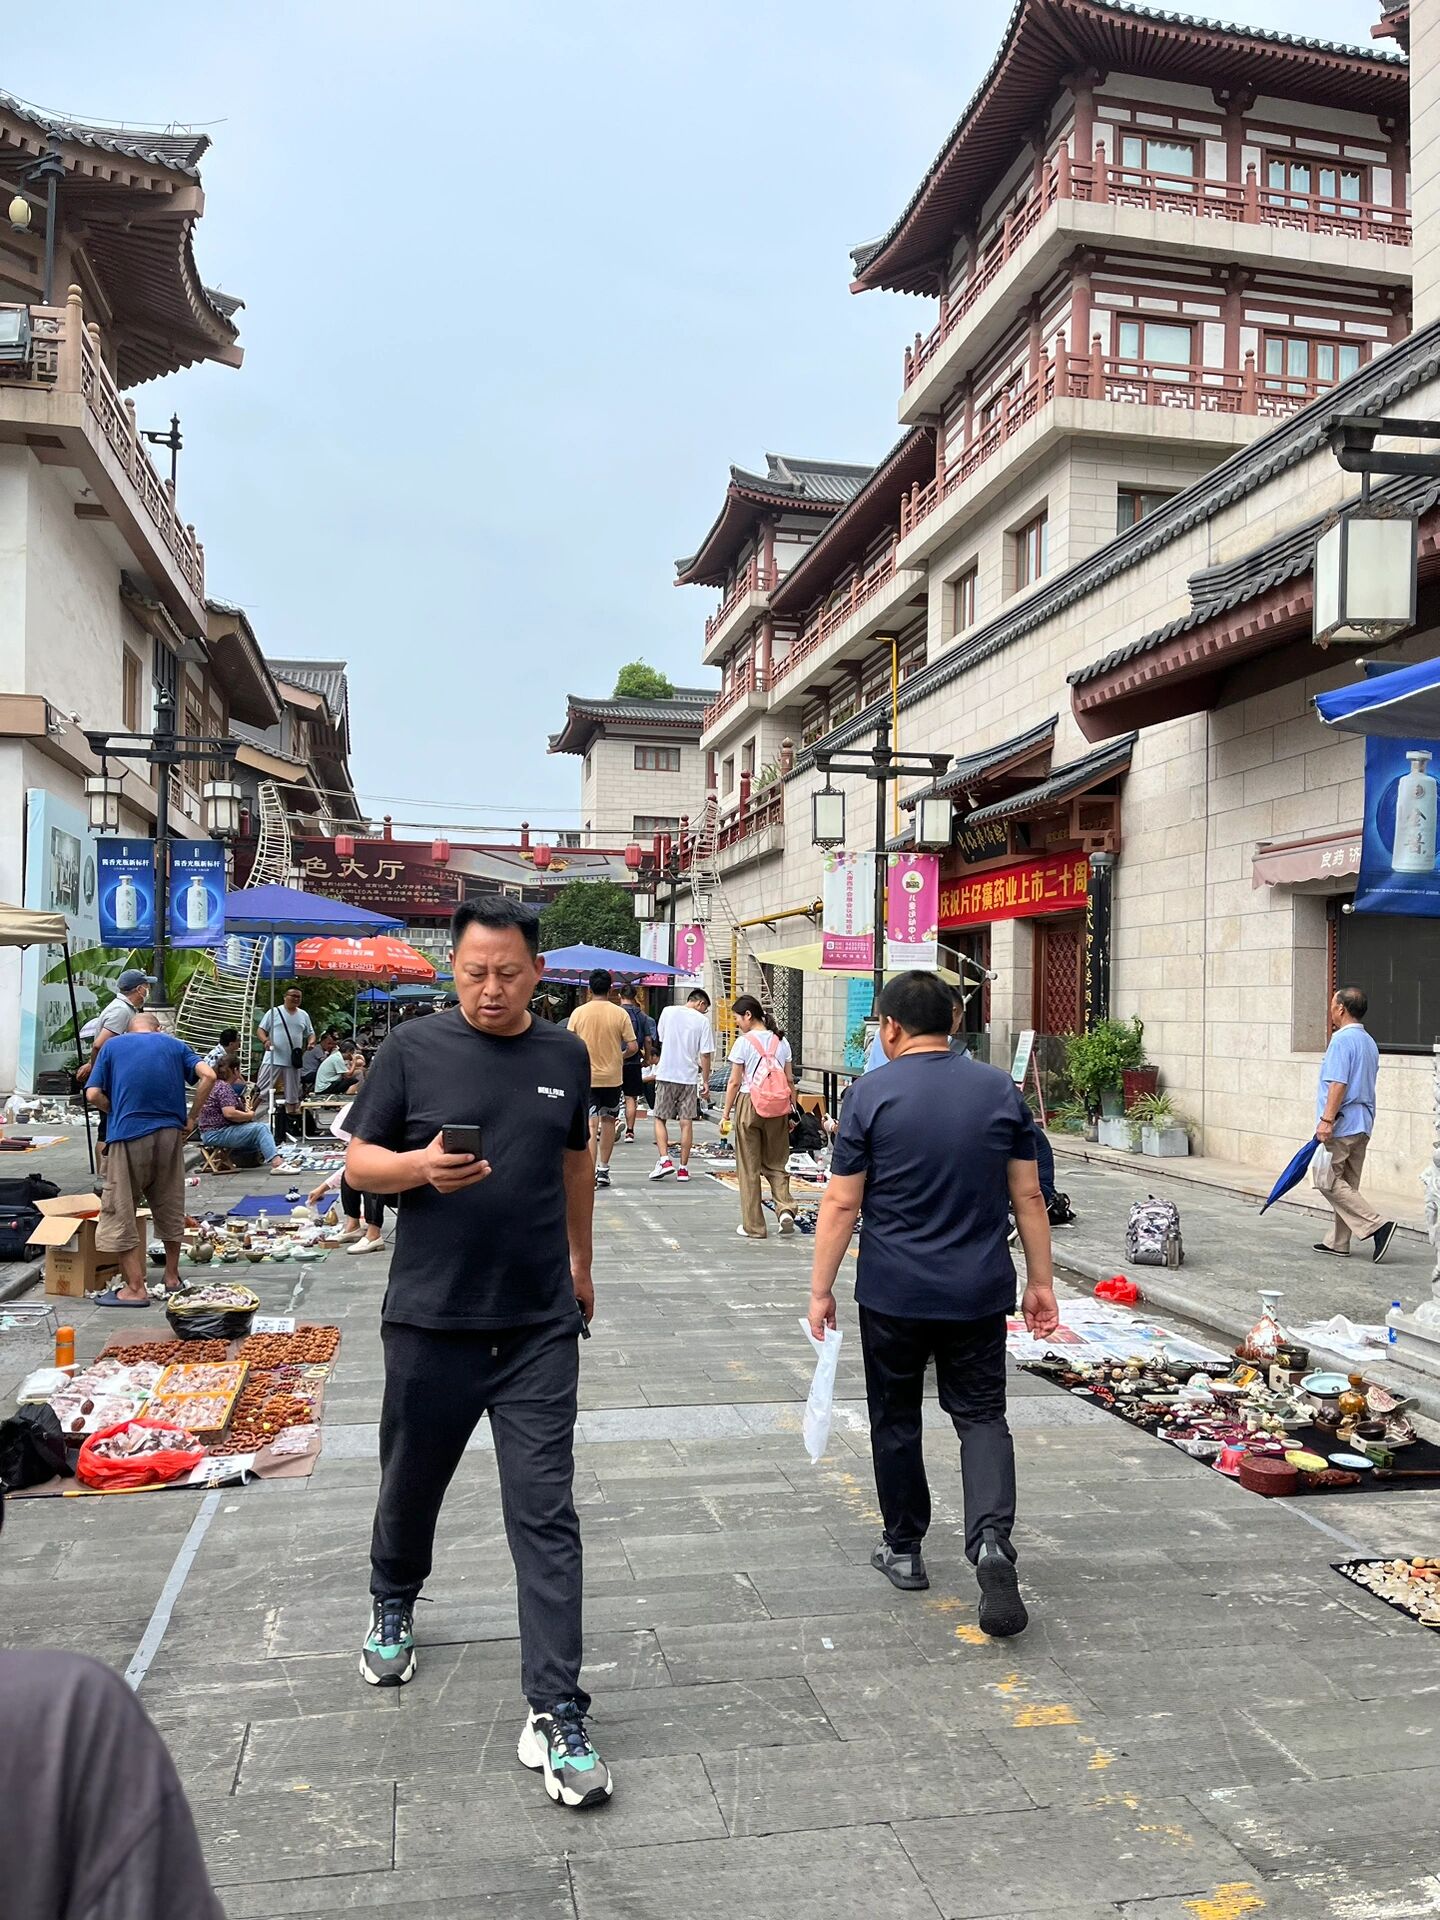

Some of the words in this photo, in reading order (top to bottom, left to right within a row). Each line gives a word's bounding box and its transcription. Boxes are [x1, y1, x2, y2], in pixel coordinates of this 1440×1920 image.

[300, 856, 406, 881] 色大厅
[1320, 849, 1345, 868] 良药
[937, 860, 1088, 919] 庆祝片仔癀药业上市二十周
